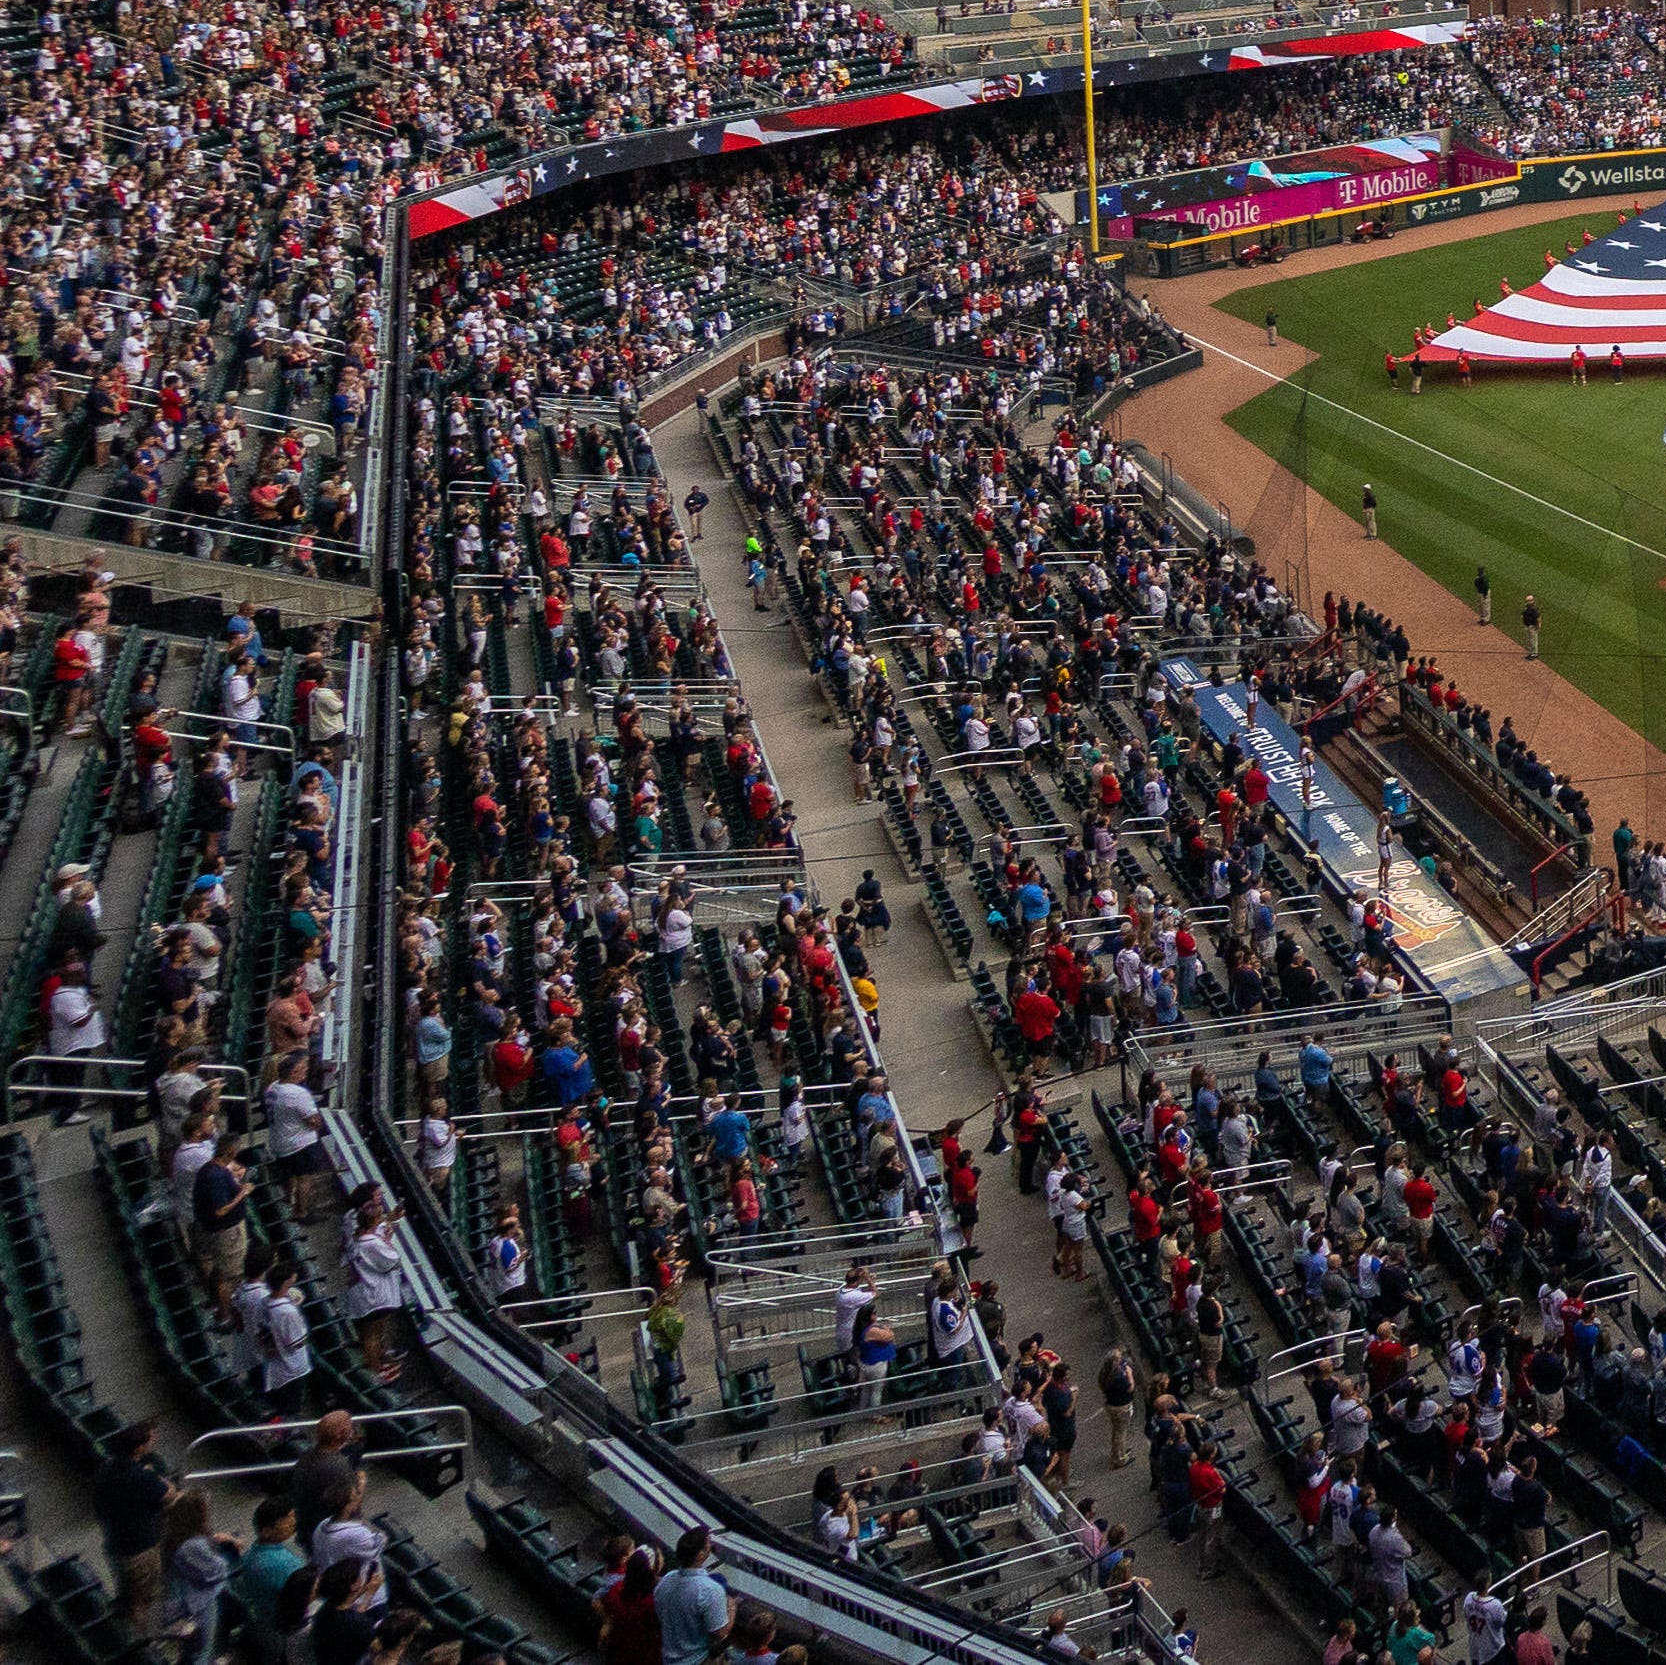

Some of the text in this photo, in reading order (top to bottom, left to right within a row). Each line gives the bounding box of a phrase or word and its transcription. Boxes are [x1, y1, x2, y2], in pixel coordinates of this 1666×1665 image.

[1362, 167, 1429, 200] Mobile
[1429, 197, 1461, 211] TYM
[1243, 727, 1295, 766] TRUIST
